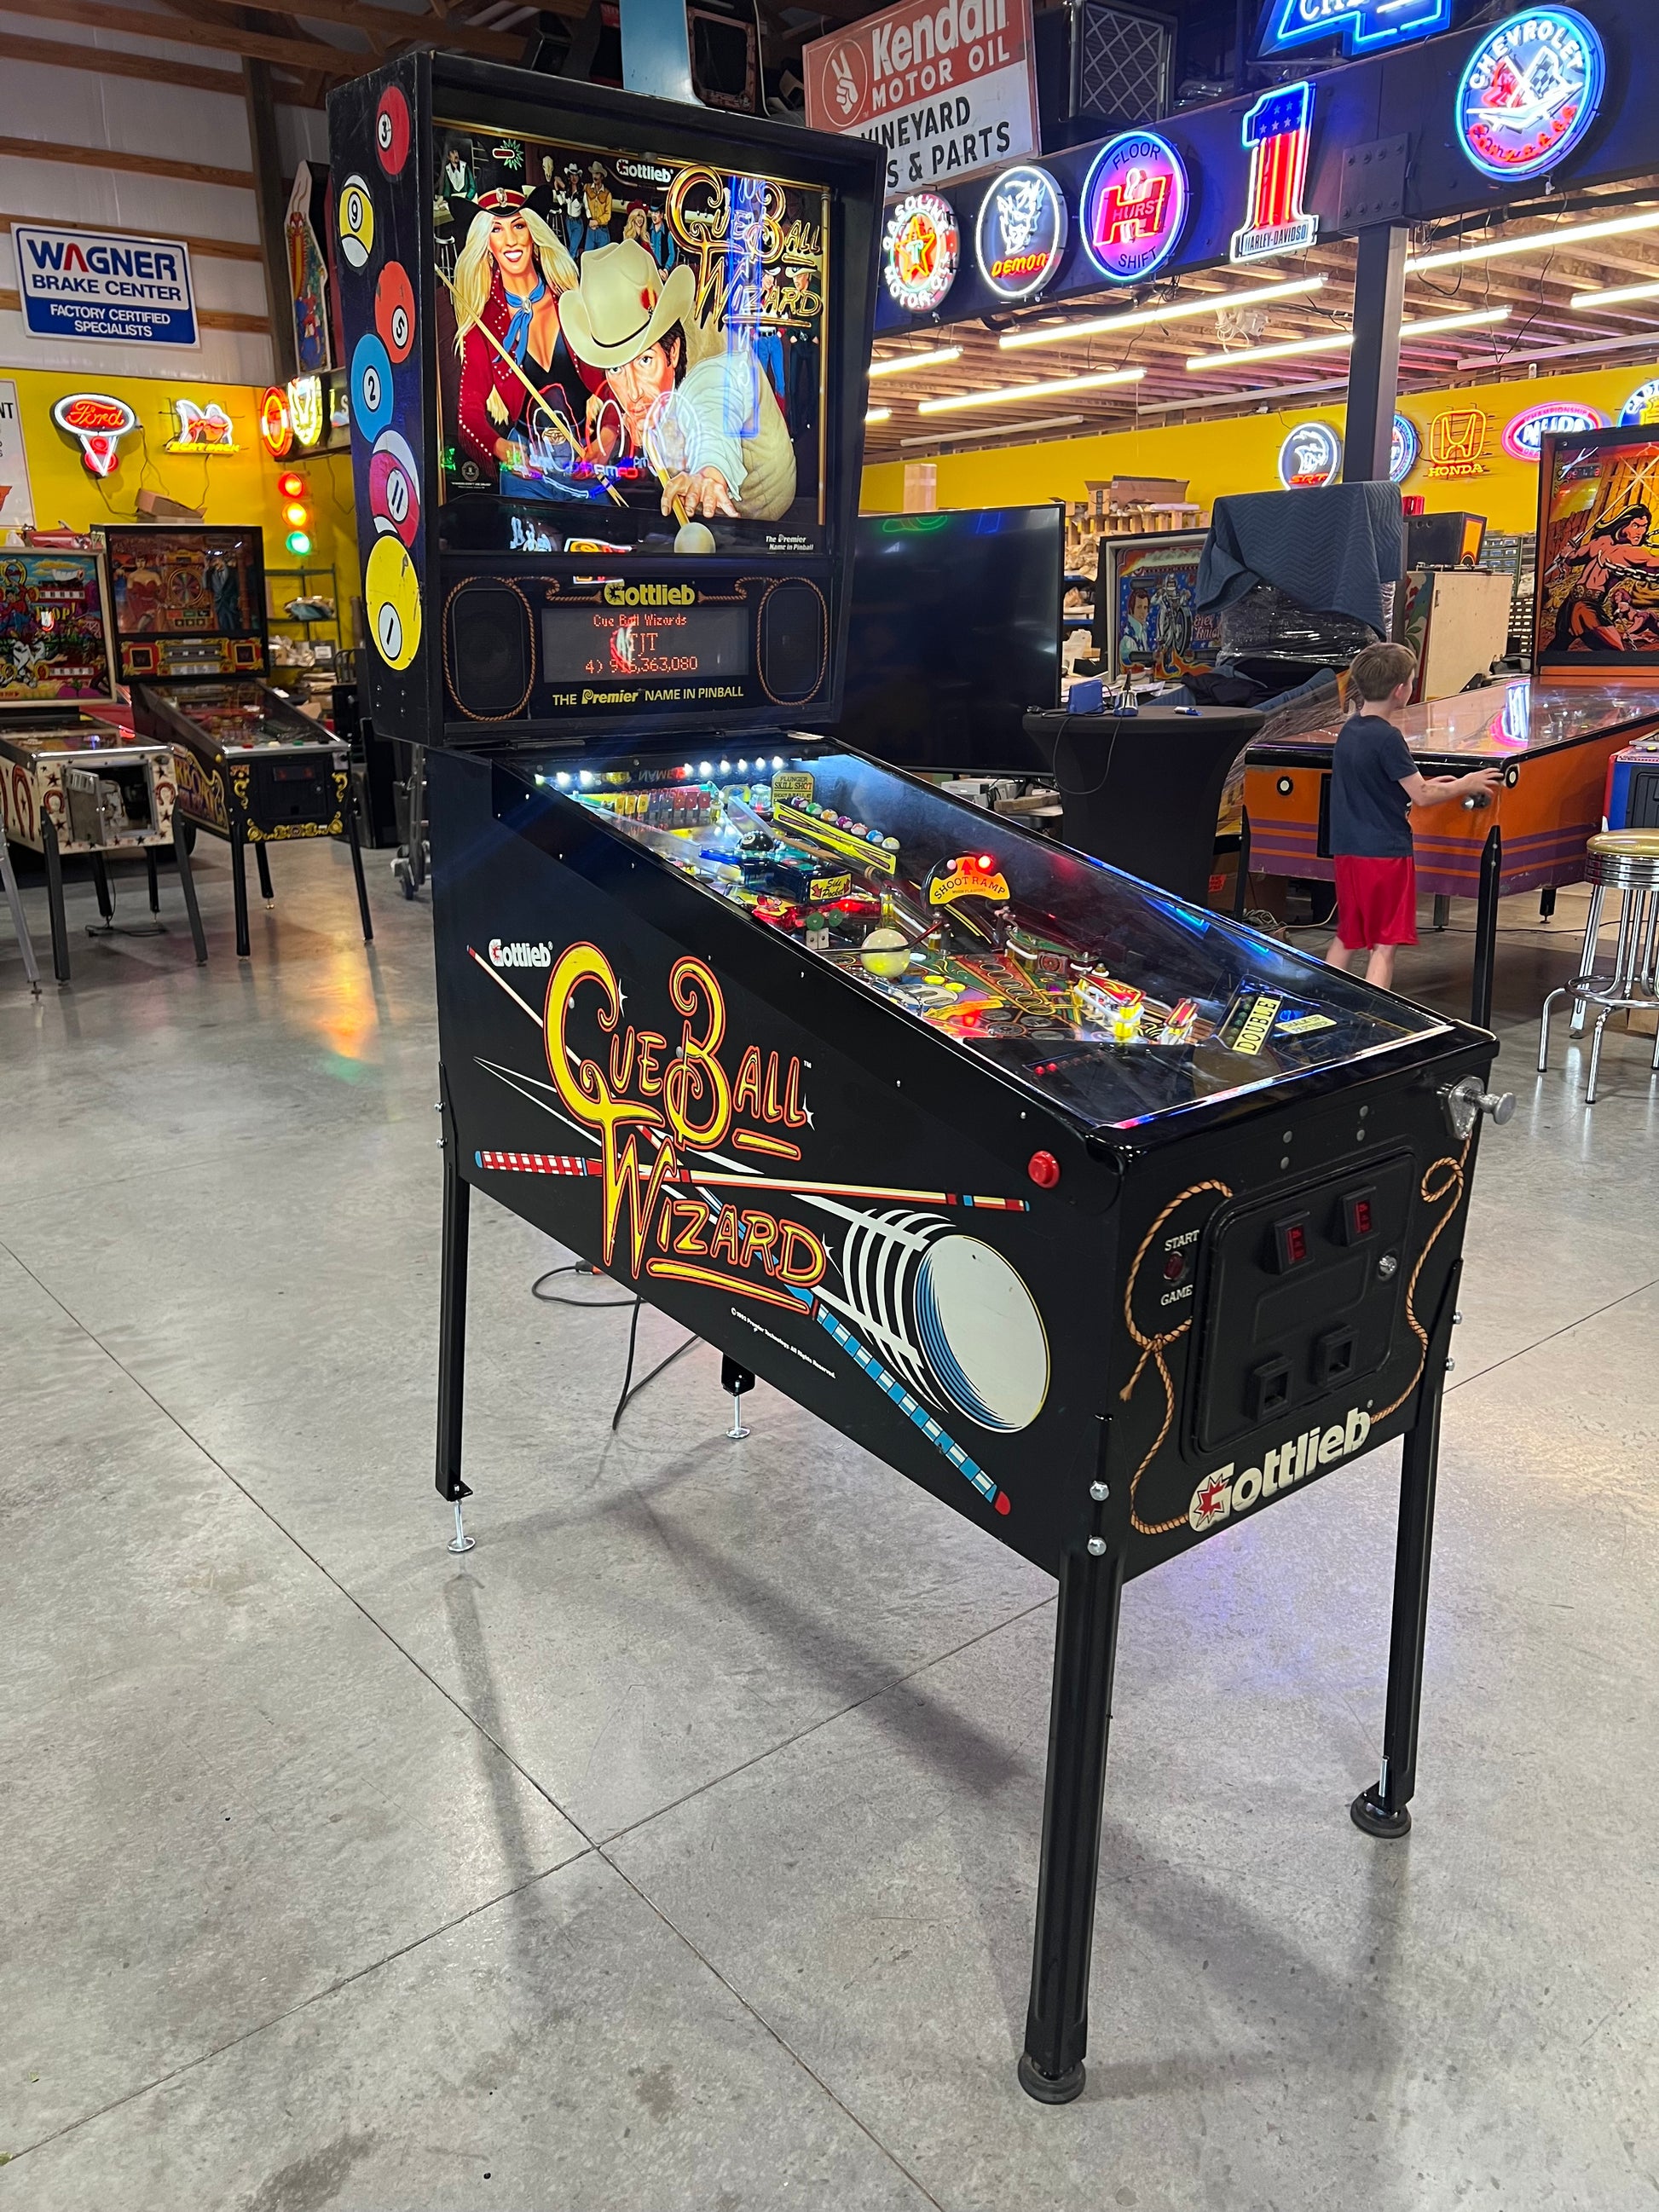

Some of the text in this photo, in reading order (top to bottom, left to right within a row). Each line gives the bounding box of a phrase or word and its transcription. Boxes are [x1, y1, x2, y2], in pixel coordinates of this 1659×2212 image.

[873, 0, 1008, 81] Kendall
[1470, 20, 1584, 90] CHEVROLET
[872, 36, 1010, 111] MOTOR OIL
[909, 152, 923, 182] &
[932, 121, 1010, 174] PARTS
[1112, 141, 1161, 170] FLOOR
[616, 159, 673, 183] Gottlieb
[1244, 223, 1309, 252] HARLEY-DAVIDSO
[26, 239, 177, 282] WAGNER
[1118, 245, 1158, 269] SHIFT
[32, 274, 182, 301] BRAKE CENTER
[49, 303, 171, 325] FACTORY CERTIFIED
[74, 320, 153, 337] SPECIALISTS
[66, 399, 125, 426] Ford
[1522, 447, 1540, 458] DRA
[1428, 463, 1484, 476] HONDA
[777, 534, 806, 543] Premier
[604, 580, 695, 606] Gottlieb
[593, 614, 615, 627] Cue
[552, 685, 744, 706] THE Premier NAME IN PINBALL
[774, 782, 793, 790] SKILL
[822, 887, 843, 898] Pocket
[934, 876, 1006, 899] SHOOT RAMP
[1236, 1001, 1277, 1052] DOUBLE
[543, 941, 808, 1152] CUE BALL
[598, 1125, 827, 1288] WIZARD
[1165, 1229, 1200, 1251] START
[1160, 1284, 1194, 1306] GAME
[1188, 1407, 1371, 1533] Gottlieb
